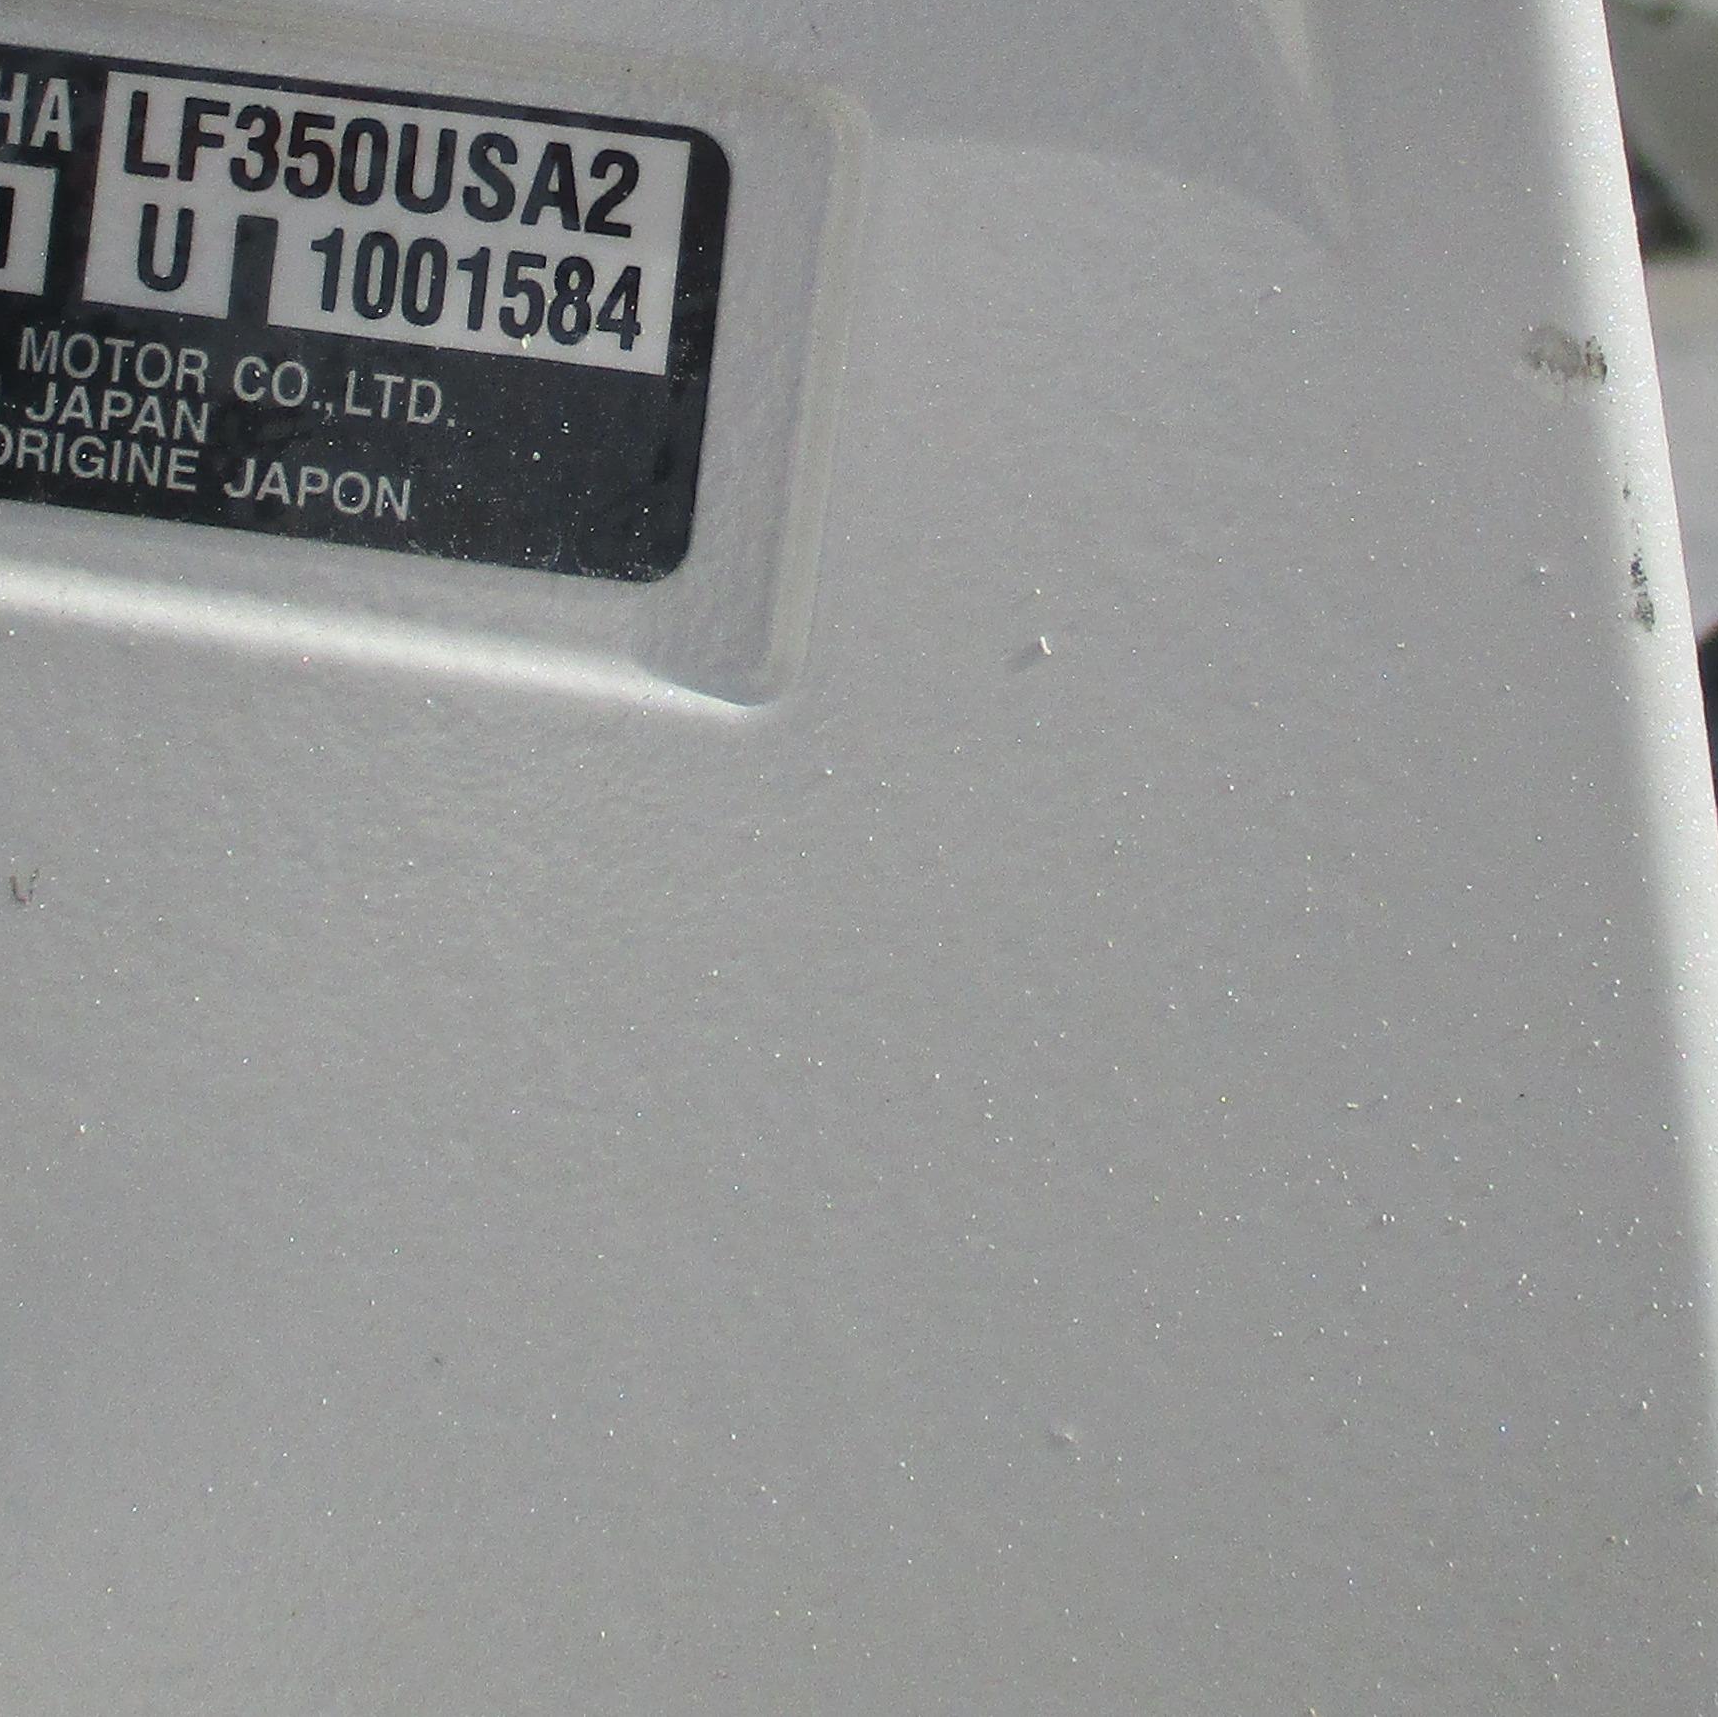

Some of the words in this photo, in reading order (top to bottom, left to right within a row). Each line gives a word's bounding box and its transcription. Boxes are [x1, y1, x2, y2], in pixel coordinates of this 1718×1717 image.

[123, 90, 641, 238] LF350USA2
[135, 203, 195, 292] U
[309, 227, 643, 351] 1001584
[17, 326, 210, 394] MOTOR
[24, 381, 210, 444] JAPAN
[223, 456, 412, 522] JAPON
